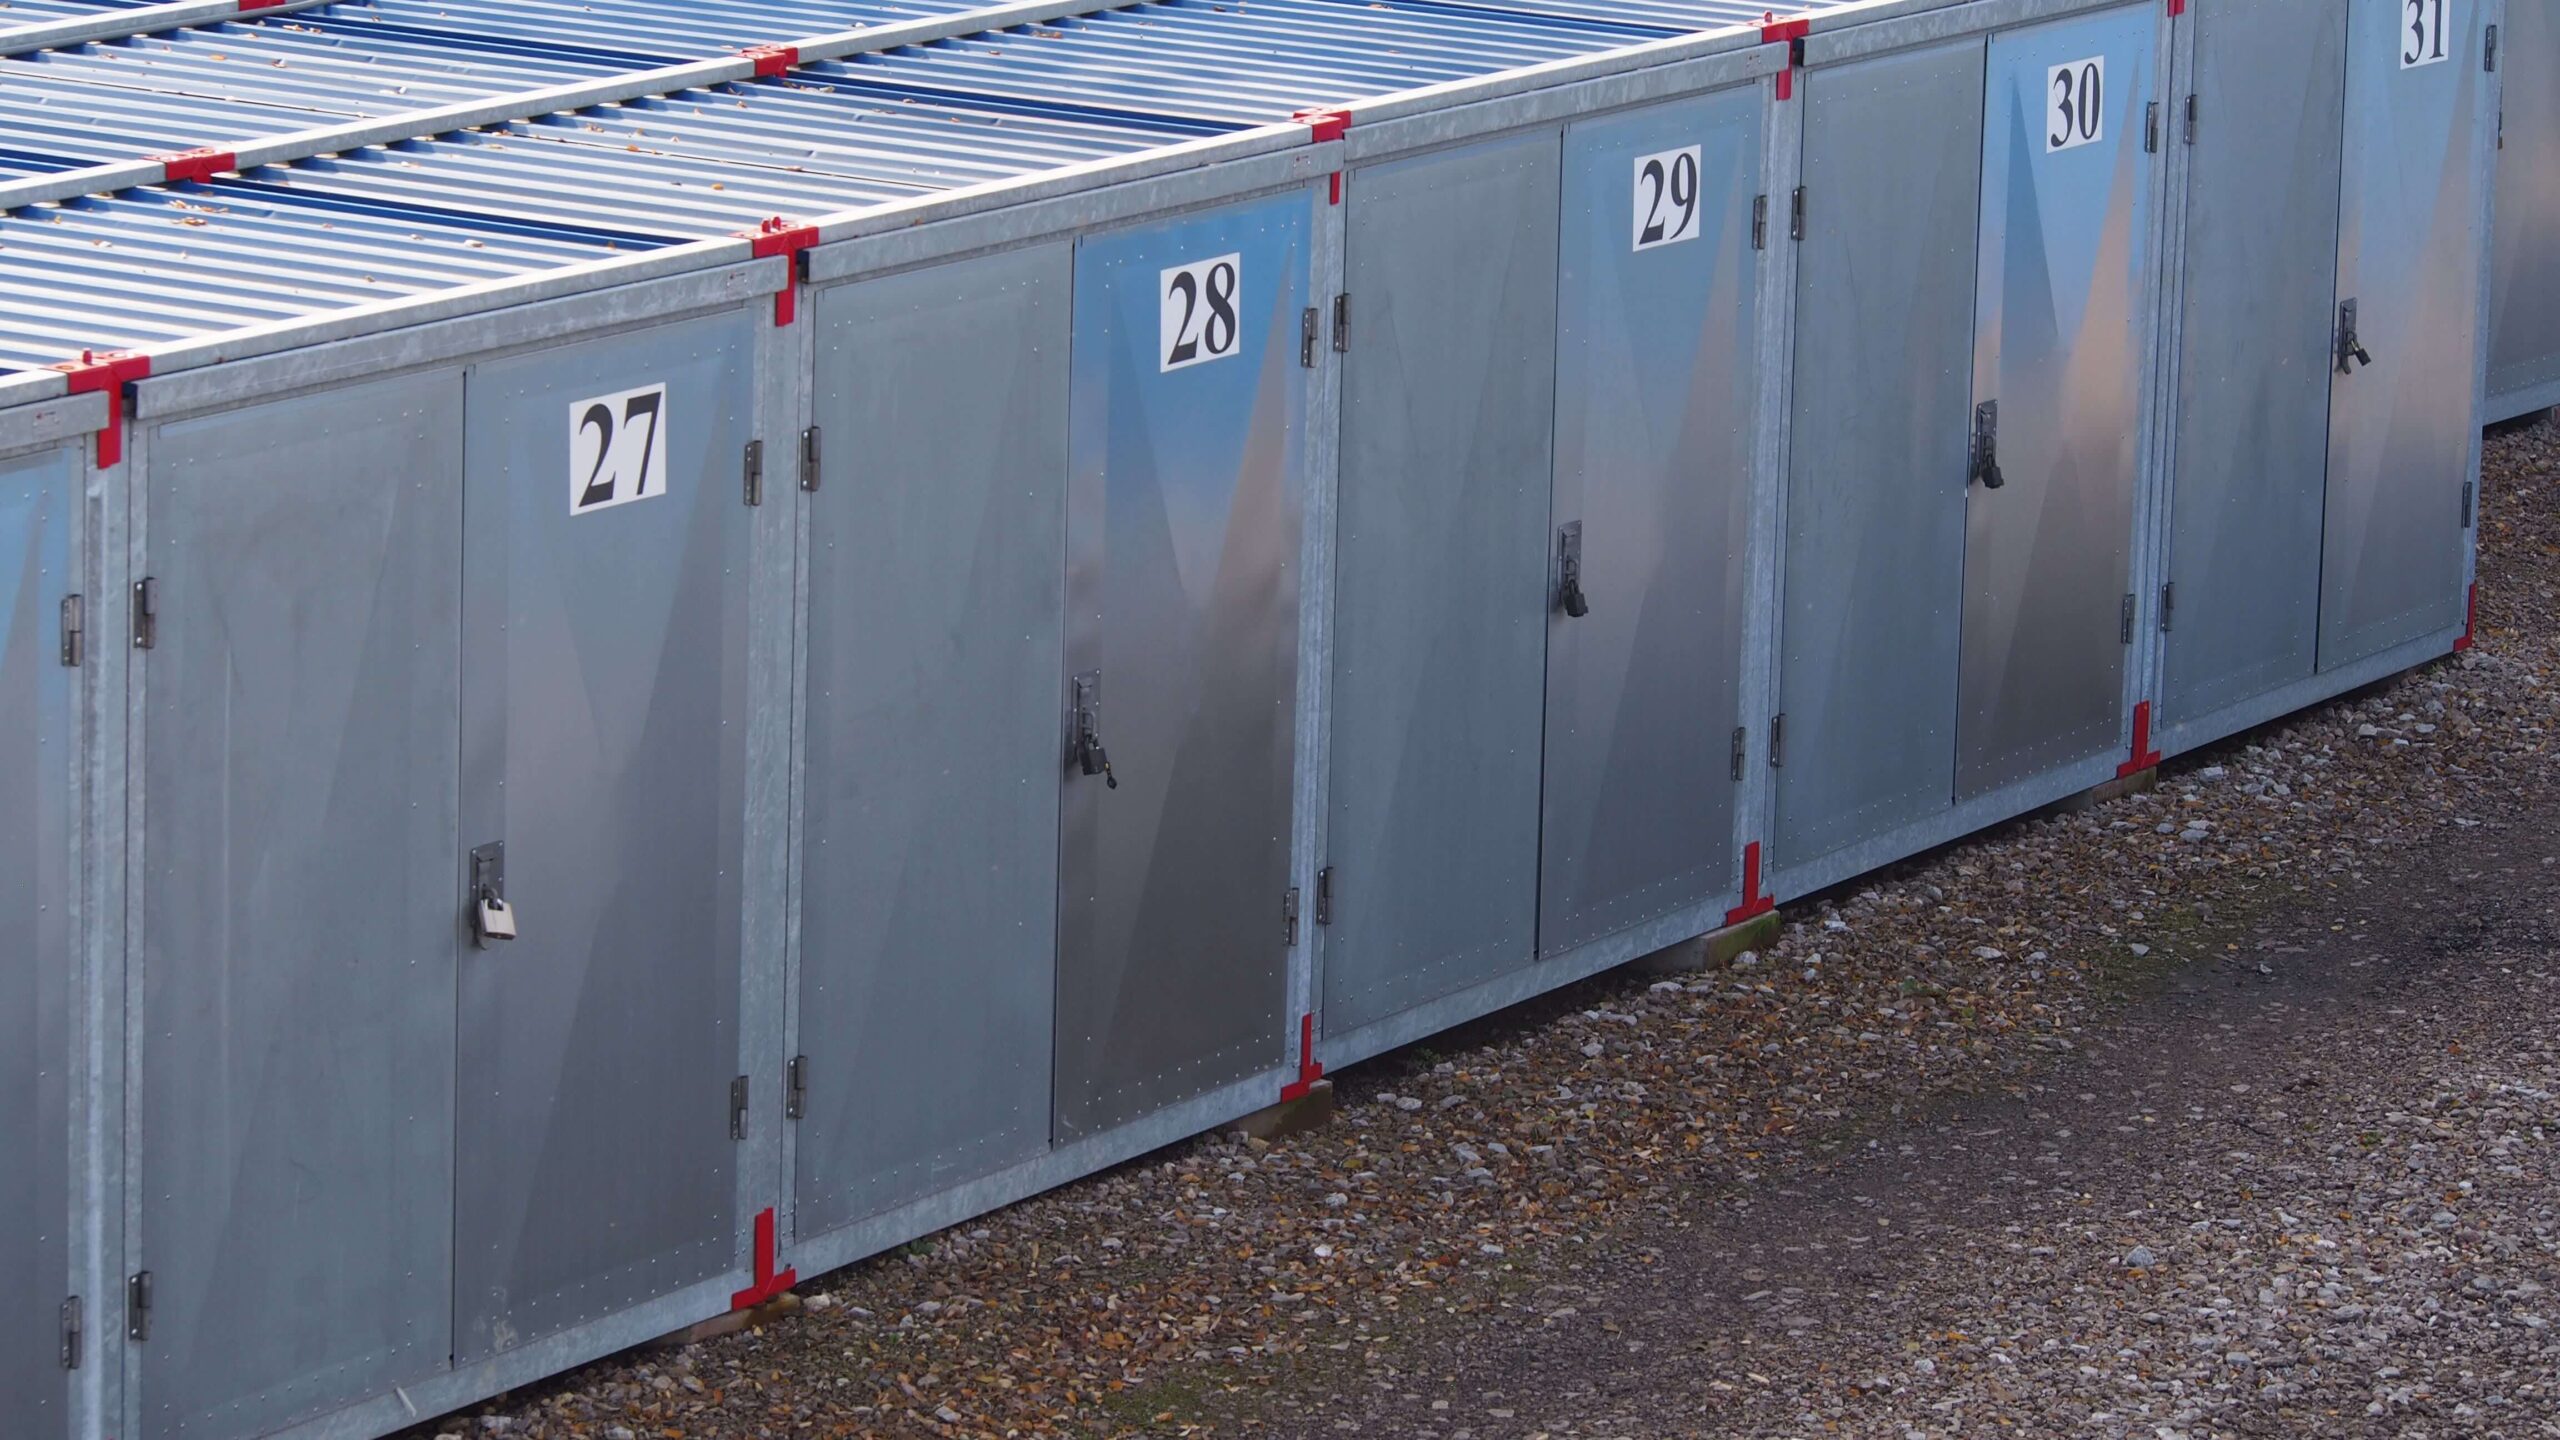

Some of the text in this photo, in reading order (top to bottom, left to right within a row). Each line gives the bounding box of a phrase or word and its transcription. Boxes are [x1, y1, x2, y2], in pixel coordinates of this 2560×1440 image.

[2404, 0, 2445, 65] 31
[2051, 62, 2101, 148] 30
[1638, 152, 1697, 245] 29
[1168, 262, 1236, 365] 28
[579, 392, 662, 508] 27
